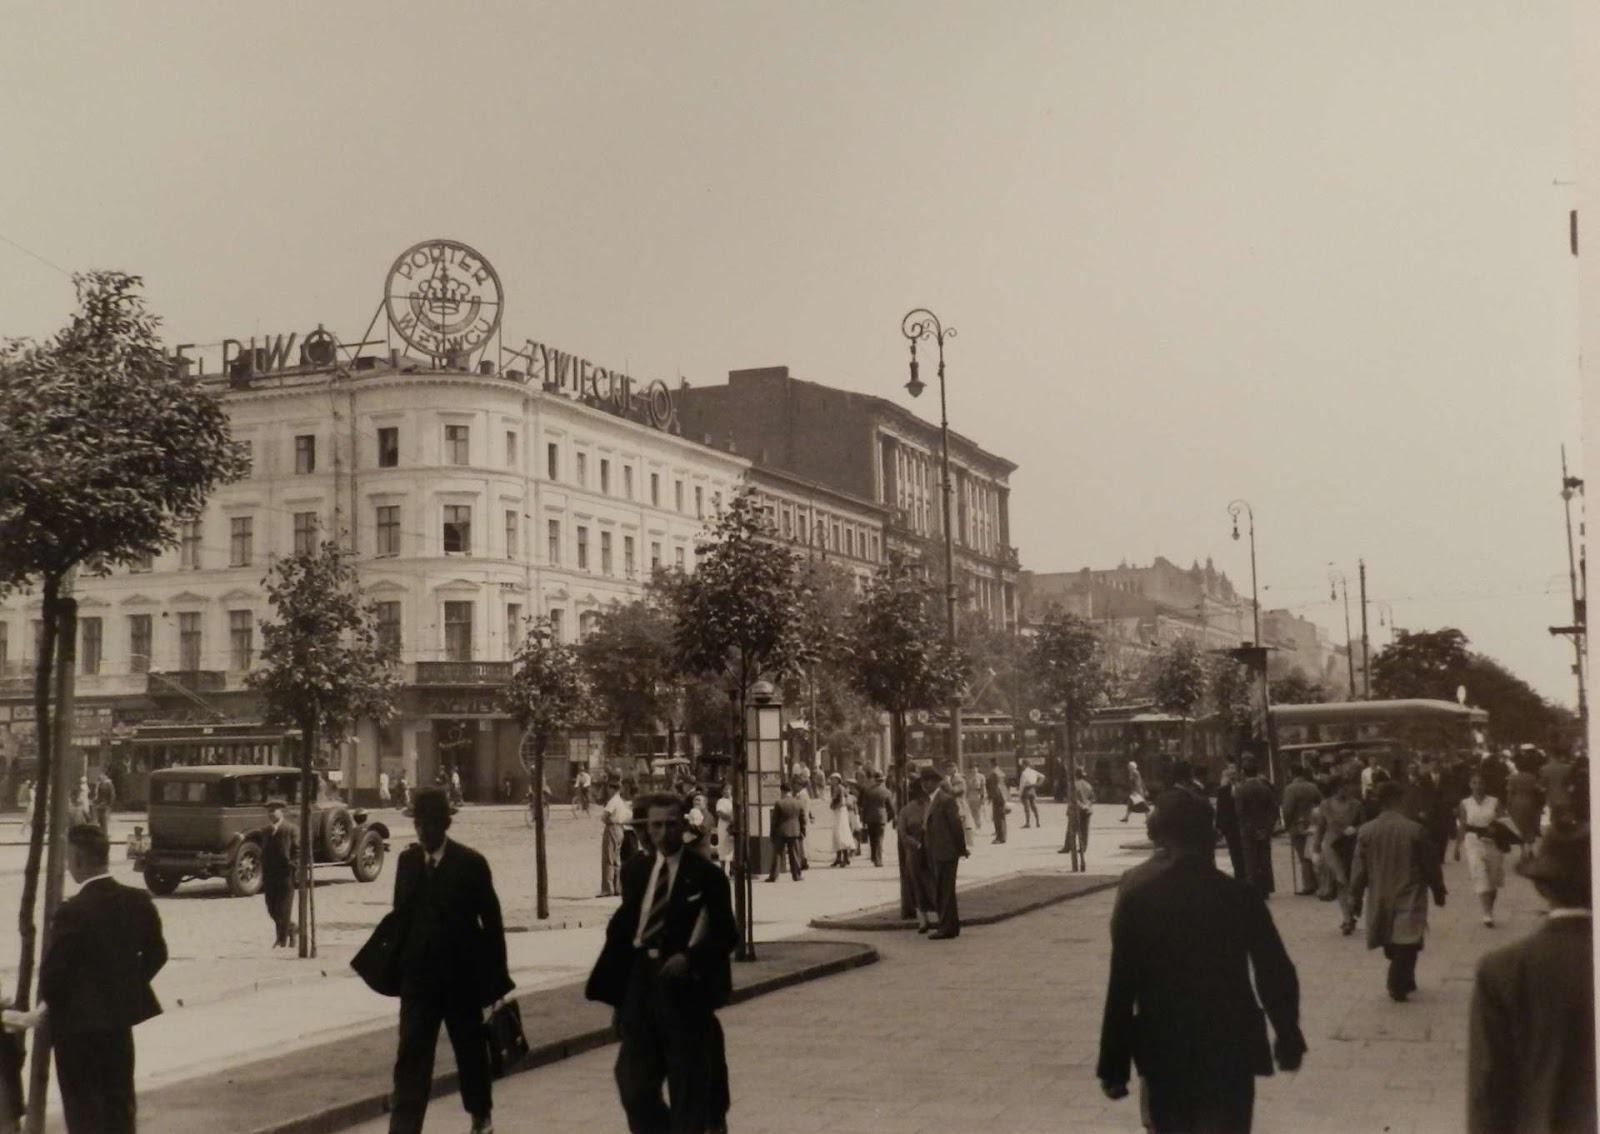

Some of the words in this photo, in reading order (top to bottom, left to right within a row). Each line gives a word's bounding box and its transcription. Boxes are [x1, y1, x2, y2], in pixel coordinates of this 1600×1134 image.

[397, 243, 488, 286] PORTER
[399, 311, 415, 331] W
[223, 329, 336, 377] PIWO
